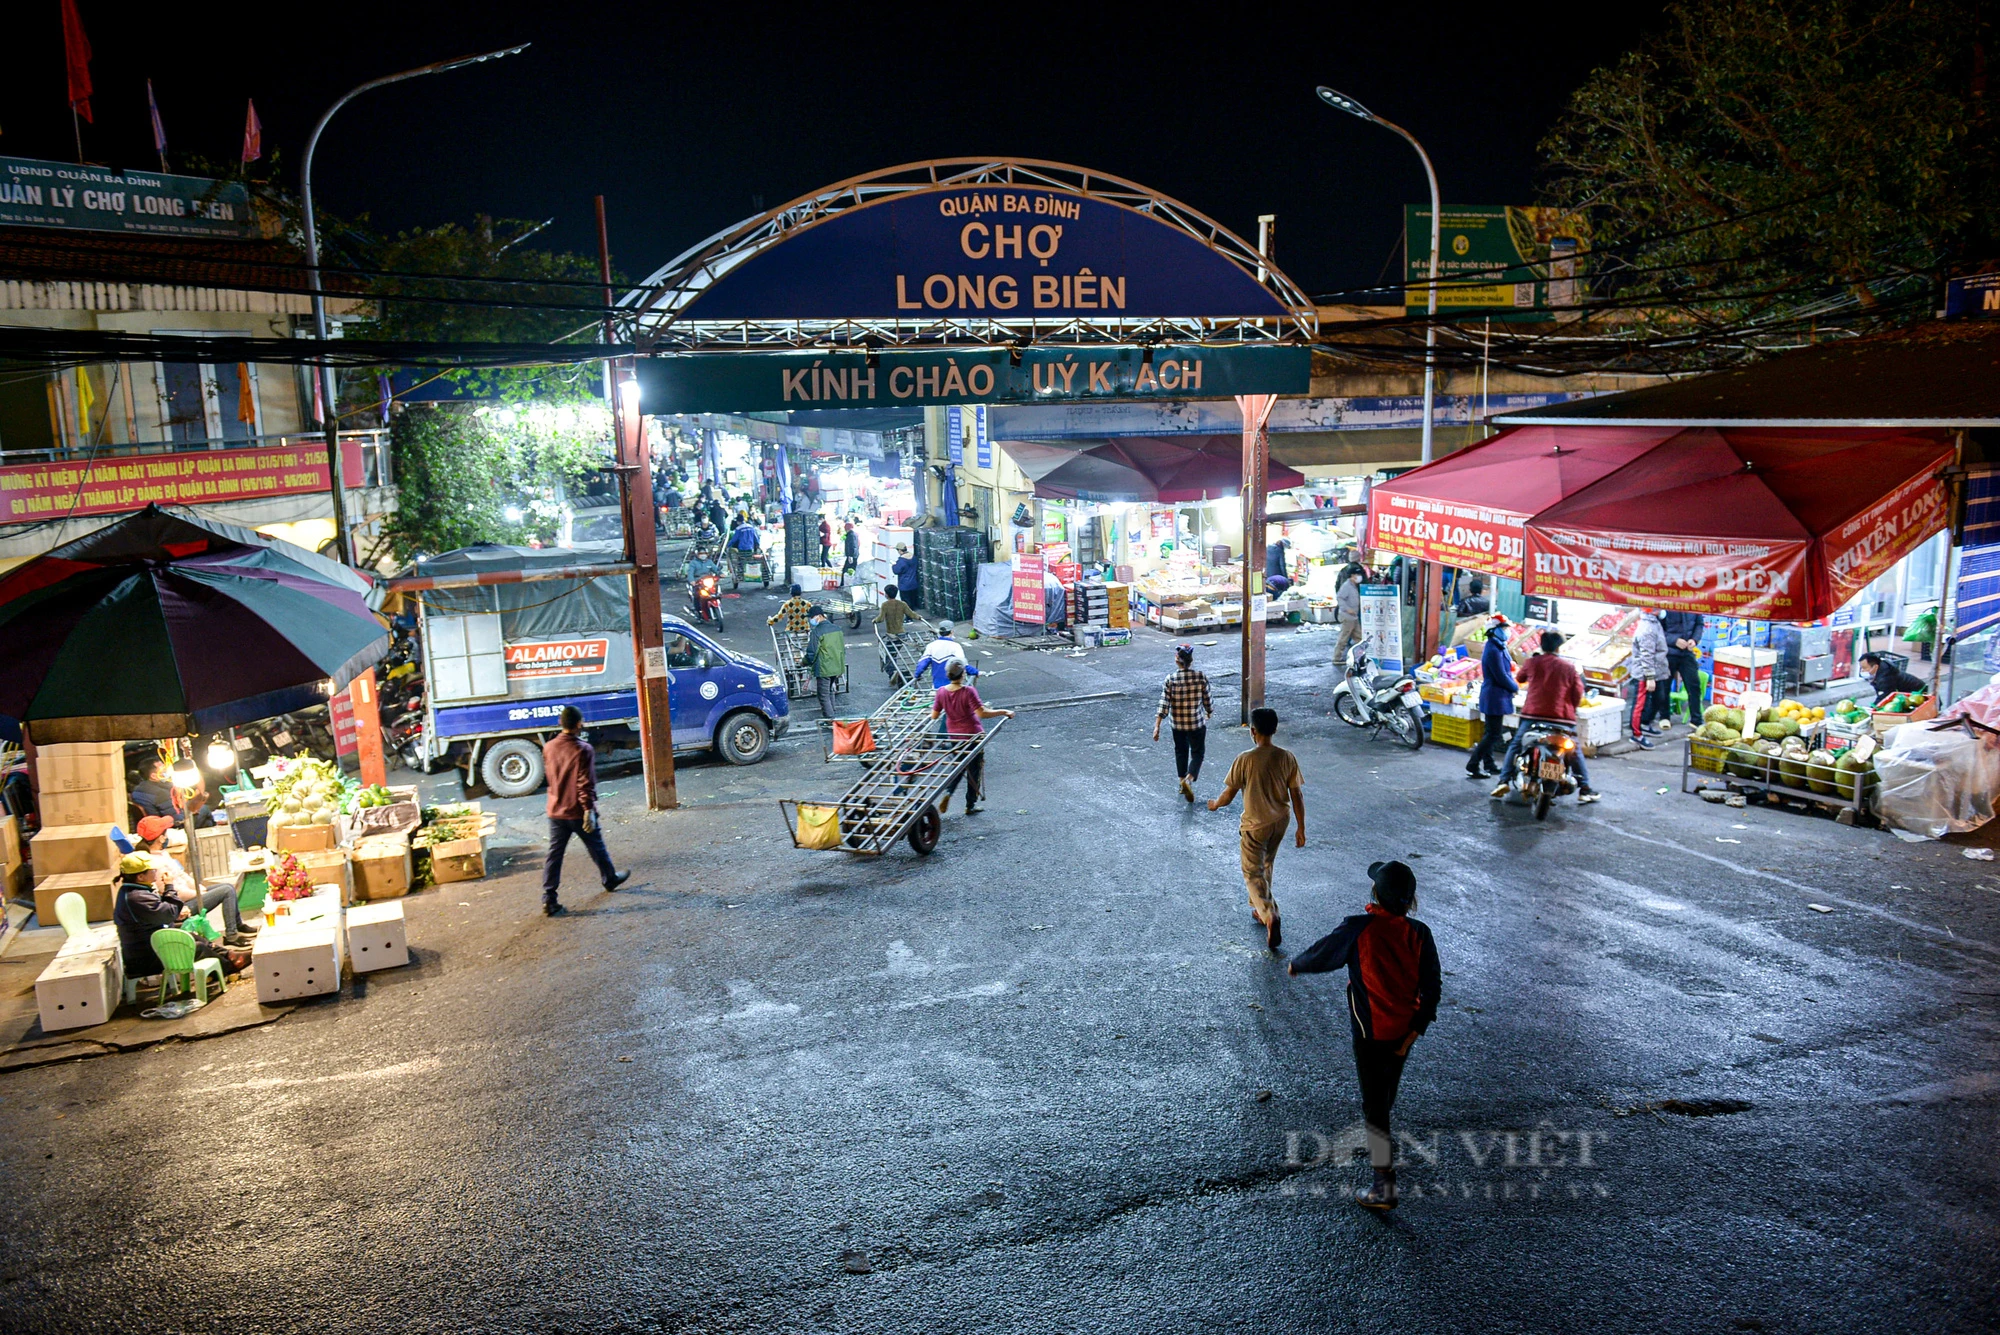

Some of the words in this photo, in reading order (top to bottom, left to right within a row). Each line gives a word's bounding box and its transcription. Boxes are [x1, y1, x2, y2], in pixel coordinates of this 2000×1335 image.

[8, 165, 53, 177] UBND
[57, 170, 101, 183] QUẬN
[104, 175, 125, 184] BA
[126, 175, 161, 187] ĐÌNH
[50, 184, 75, 208] LÝ
[82, 189, 126, 216] CHỢ
[133, 194, 185, 217] LONG
[939, 192, 998, 218] QUẬN
[1003, 194, 1031, 212] BA
[1034, 194, 1081, 220] ĐÌNH
[960, 222, 1064, 267] CHỢ
[896, 274, 1019, 310] LONG
[1032, 267, 1126, 309] BIÊN
[782, 360, 876, 401] KÍNH
[889, 358, 995, 399] CHÀO
[1007, 354, 1079, 394] UÝ
[34, 467, 48, 488] KỶ
[50, 468, 79, 489] NIỆM
[94, 465, 119, 483] NĂM
[119, 462, 145, 480] NGÀY
[146, 460, 177, 478] THÀNH
[178, 458, 195, 478] LẬP
[197, 456, 221, 476] QUẬN
[222, 457, 237, 472] BA
[235, 454, 256, 470] ĐÌNH
[11, 498, 26, 514] 60
[26, 494, 53, 512] NĂM
[53, 491, 81, 510] NGÀY
[83, 488, 117, 507] THÀNH
[117, 486, 135, 506] LẬP
[137, 481, 164, 501] ĐẢNG
[164, 481, 178, 501] BỘ
[179, 479, 204, 499] QUẬN
[204, 480, 218, 494] BA
[218, 477, 239, 494] ĐÌNH
[1441, 524, 1494, 552] LONG
[1497, 534, 1524, 558] BI
[1628, 561, 1707, 588] LONG
[1715, 563, 1791, 595] BIÊN
[505, 644, 599, 663] ALAMOVE
